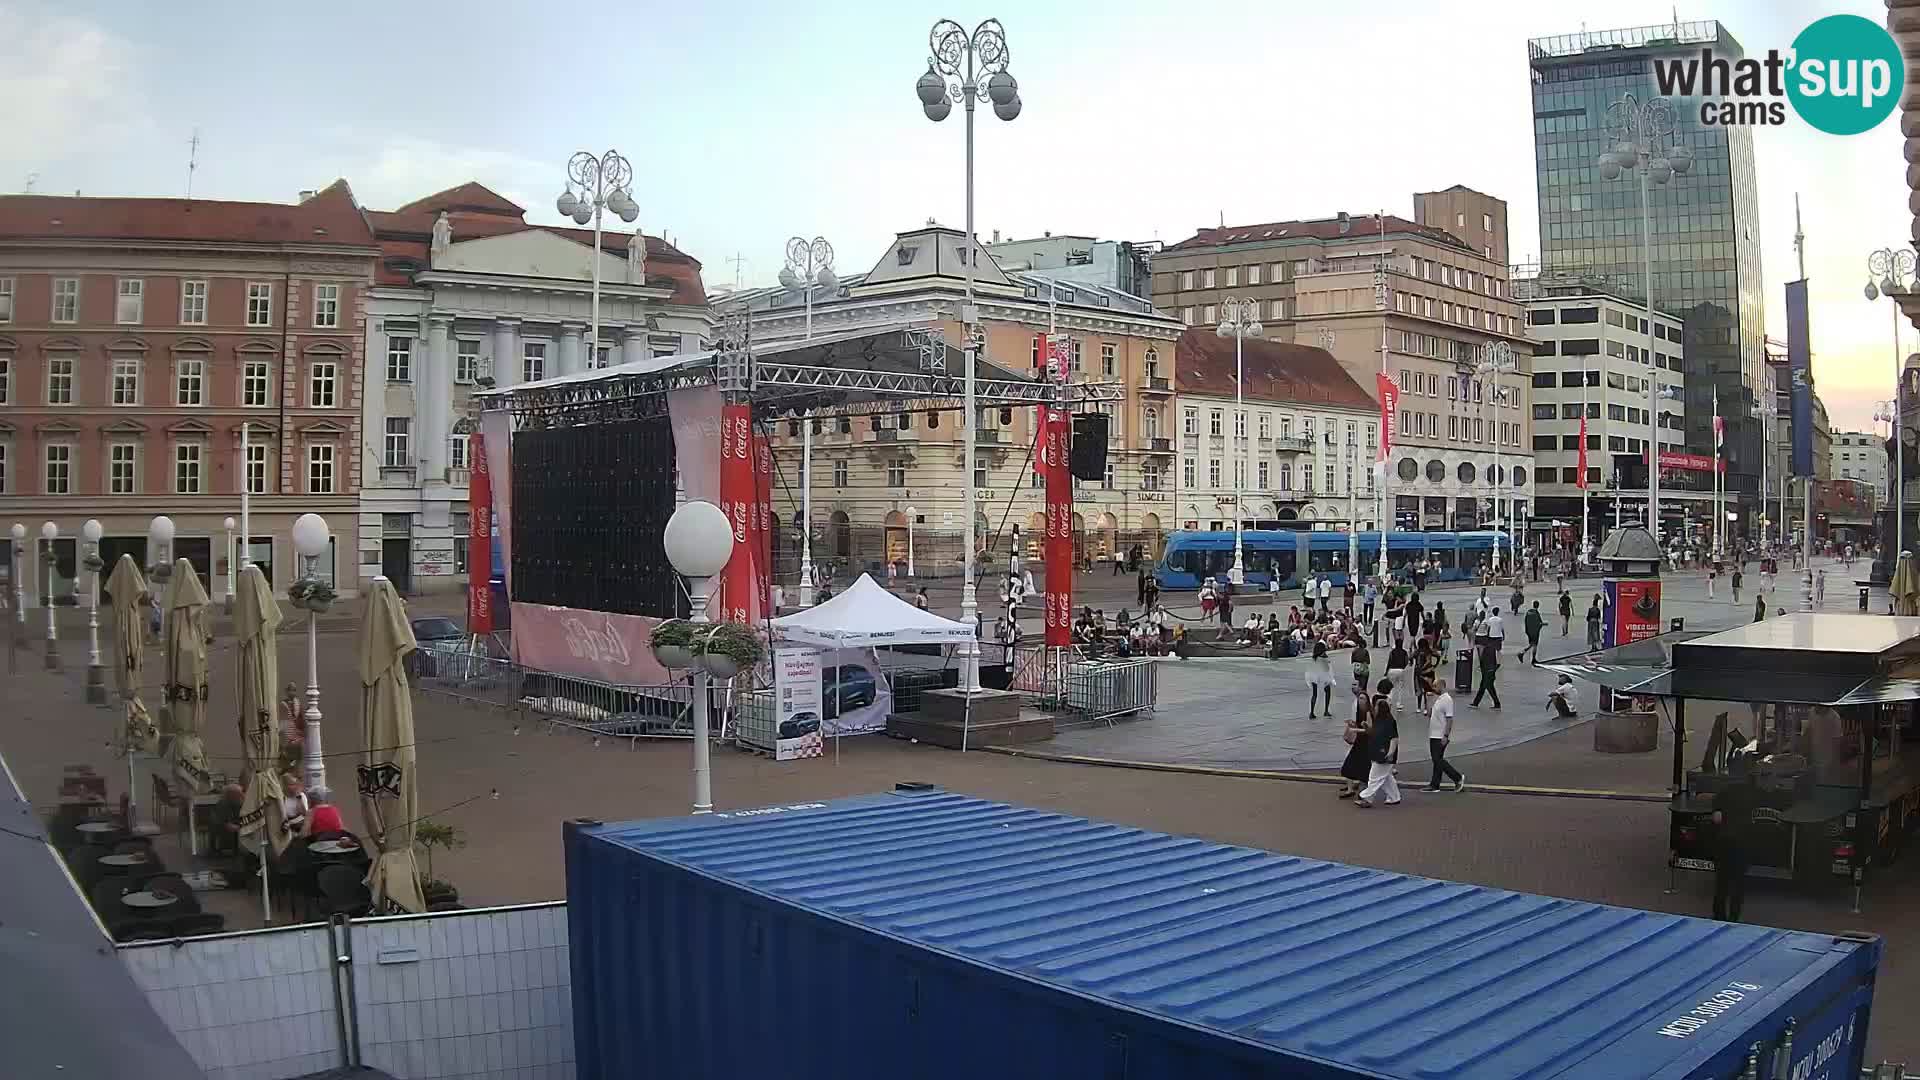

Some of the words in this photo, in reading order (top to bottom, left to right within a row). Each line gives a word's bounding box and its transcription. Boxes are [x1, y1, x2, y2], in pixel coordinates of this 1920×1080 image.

[960, 489, 996, 500] SGER
[1625, 623, 1646, 631] VIDEO
[1657, 1015, 1708, 1039] MCDU
[1691, 989, 1745, 1018] 300629
